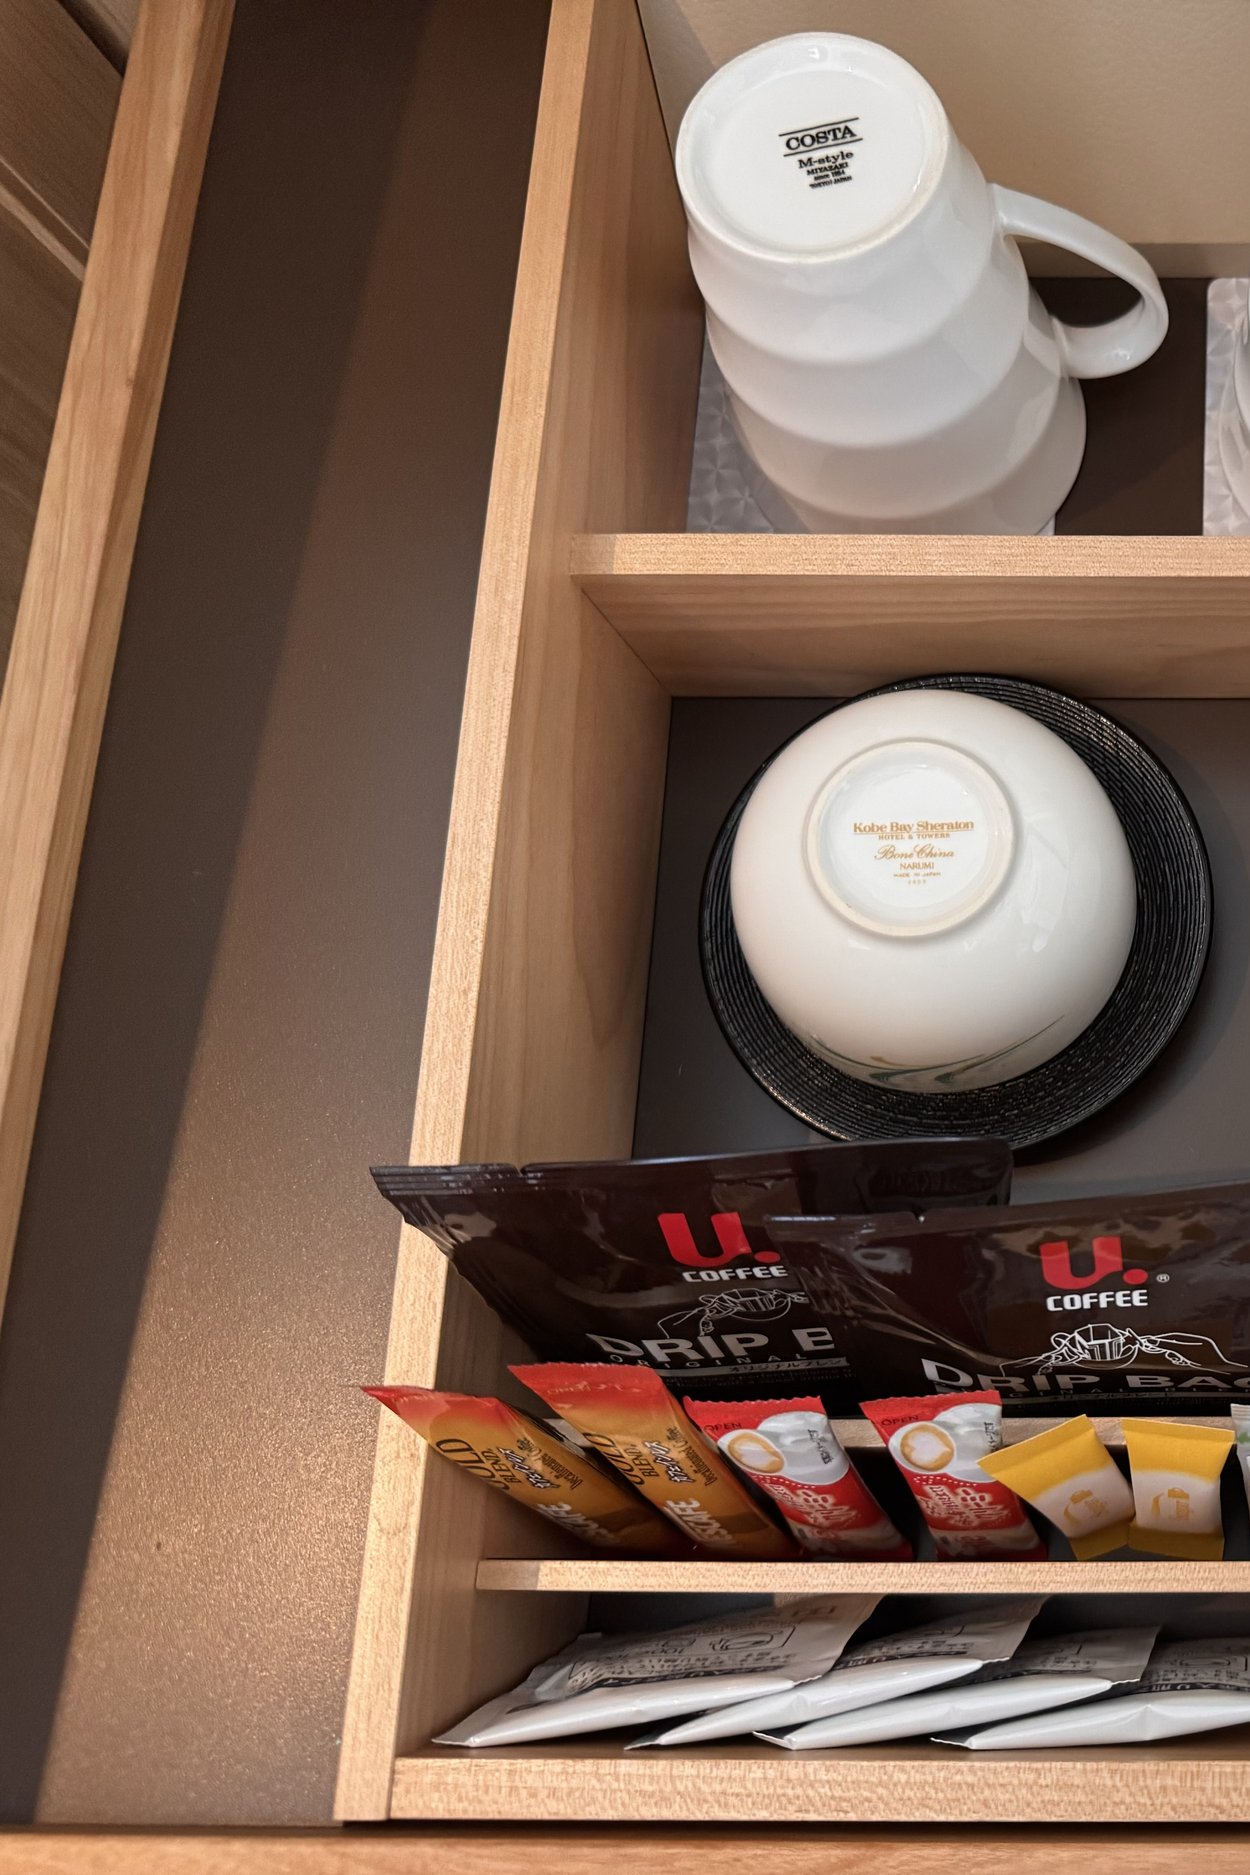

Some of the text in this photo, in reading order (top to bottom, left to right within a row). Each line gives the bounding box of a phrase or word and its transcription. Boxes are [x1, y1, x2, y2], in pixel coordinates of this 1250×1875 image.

[786, 124, 857, 150] COSTA
[798, 151, 854, 169] M-style
[806, 162, 849, 176] MIYAZAKI
[853, 820, 975, 834] Kobe Bay Sheraton
[874, 844, 954, 860] Bone China
[900, 862, 934, 870] NARUMI
[682, 1266, 788, 1282] COFFEE
[1046, 1290, 1148, 1311] COFFEE
[586, 1333, 769, 1363] DRIP
[921, 1358, 1100, 1392] DRIP
[704, 1422, 742, 1432] OPEN
[881, 1416, 919, 1426] OPEN
[624, 1444, 660, 1478] BLEND
